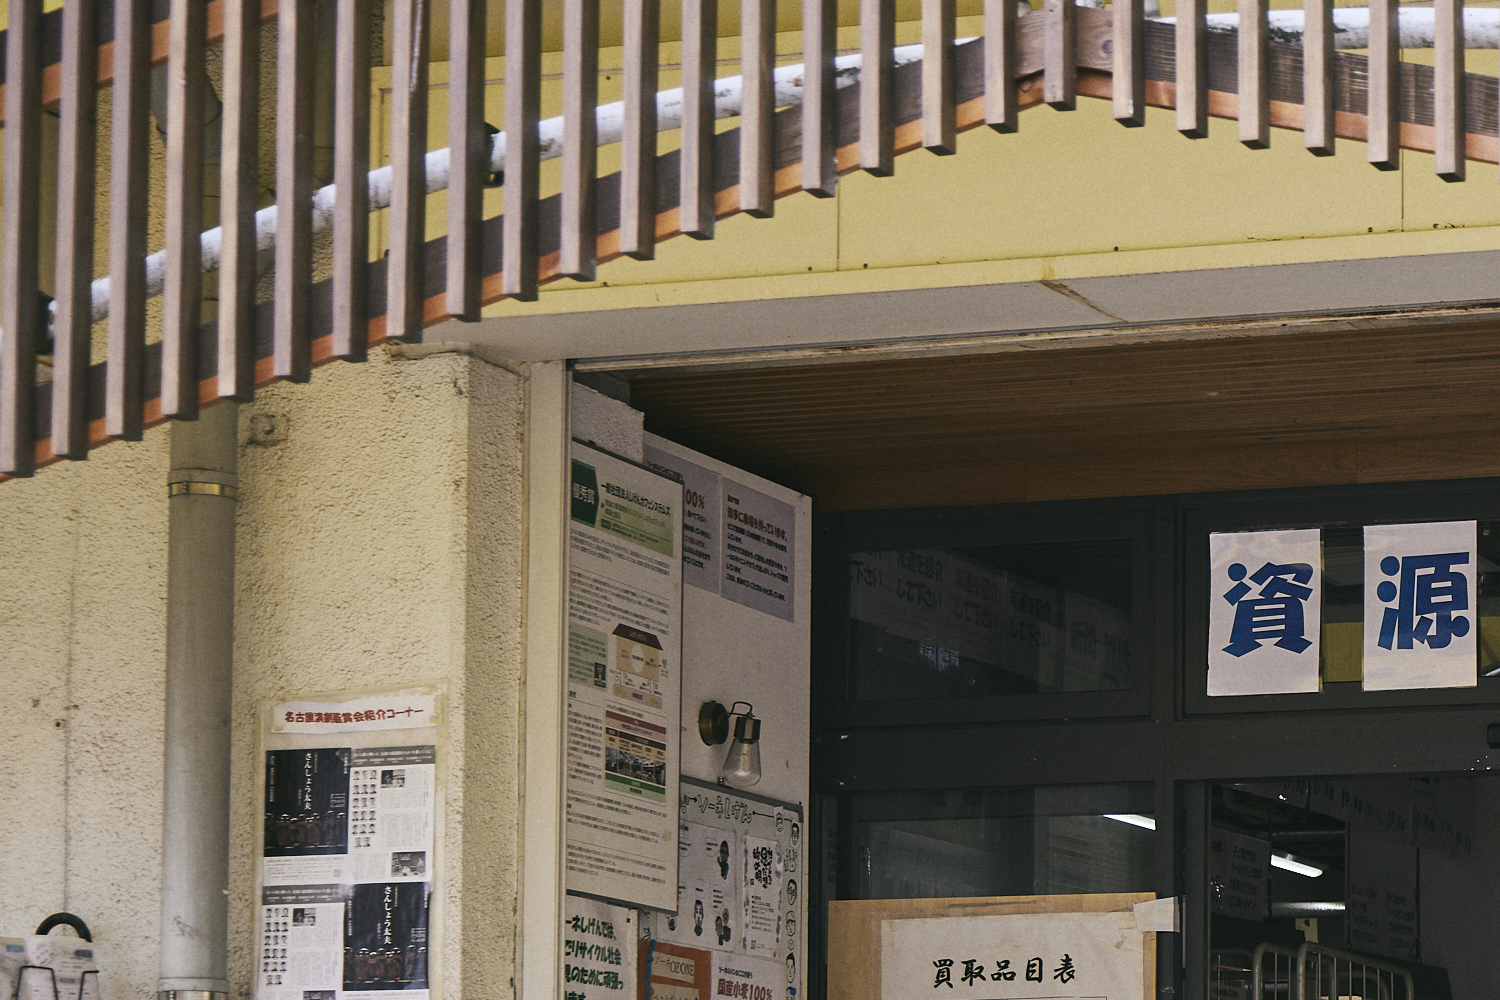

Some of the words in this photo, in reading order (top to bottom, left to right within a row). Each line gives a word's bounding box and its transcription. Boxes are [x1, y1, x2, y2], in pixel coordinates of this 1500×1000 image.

[1222, 560, 1471, 658] 資源
[932, 954, 1076, 988] 買取品目表
